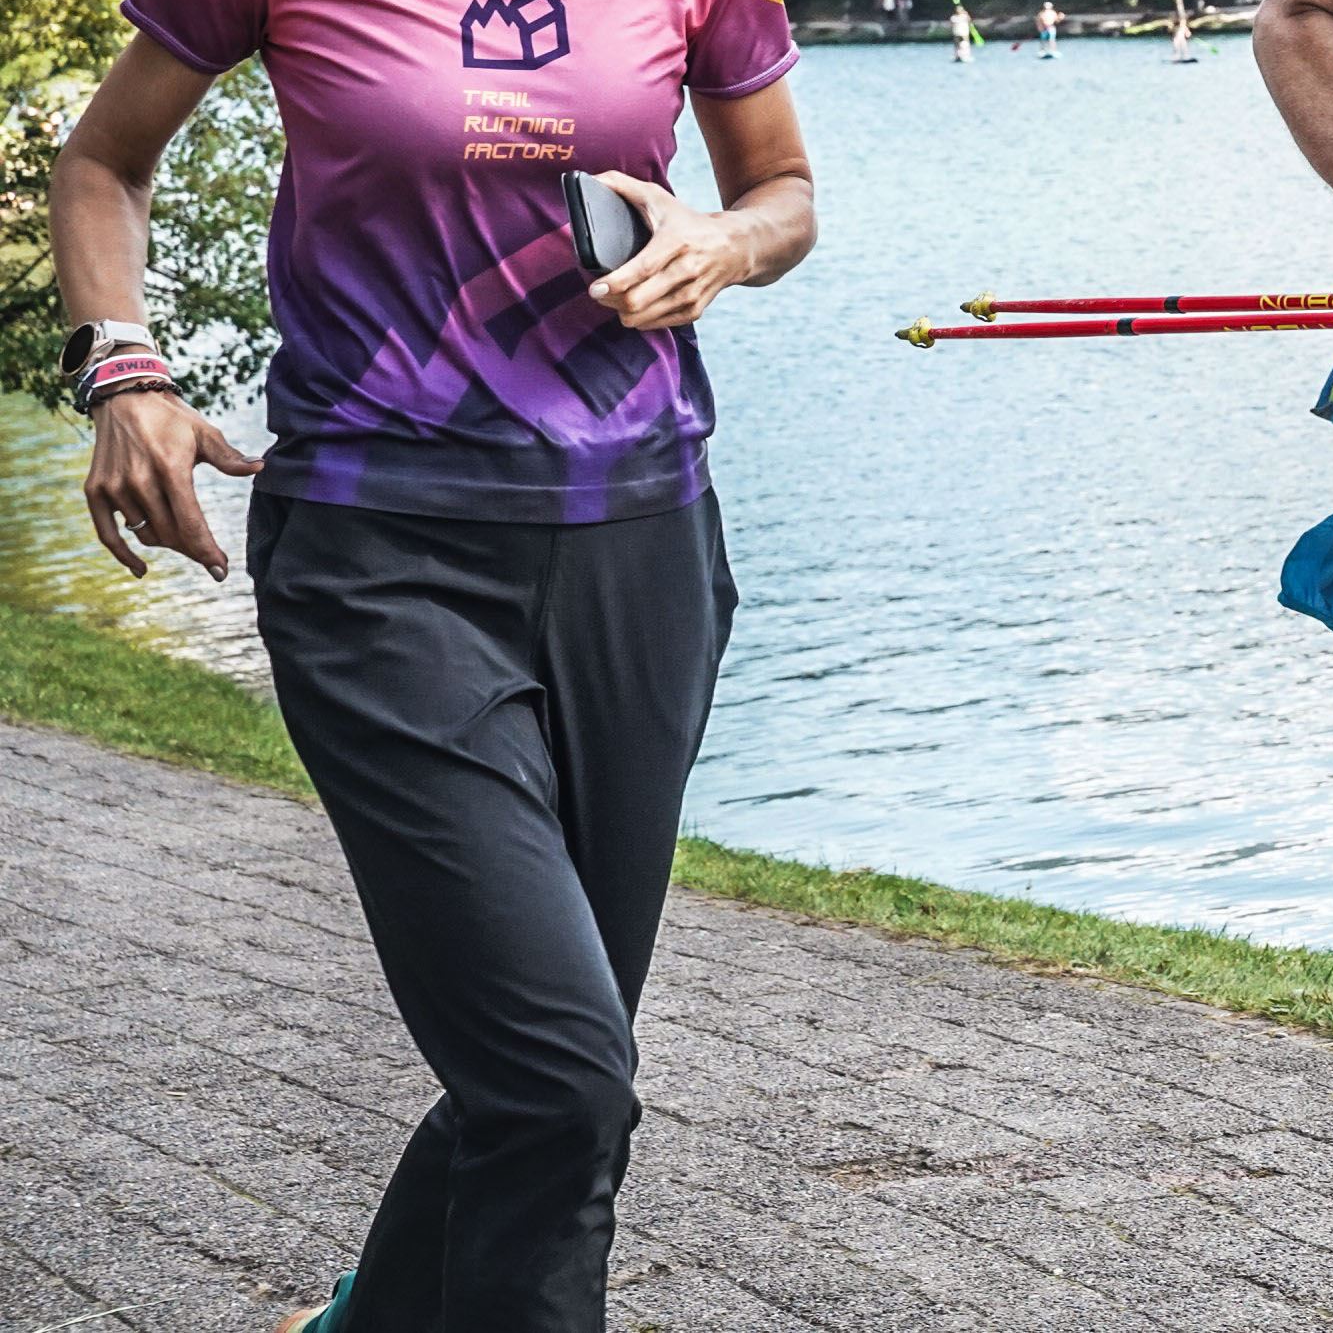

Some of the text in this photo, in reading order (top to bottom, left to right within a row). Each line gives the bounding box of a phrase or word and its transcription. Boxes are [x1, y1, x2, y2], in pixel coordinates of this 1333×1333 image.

[464, 90, 531, 108] TRAIL
[464, 116, 575, 135] RUNNING
[464, 142, 575, 161] FACTORY
